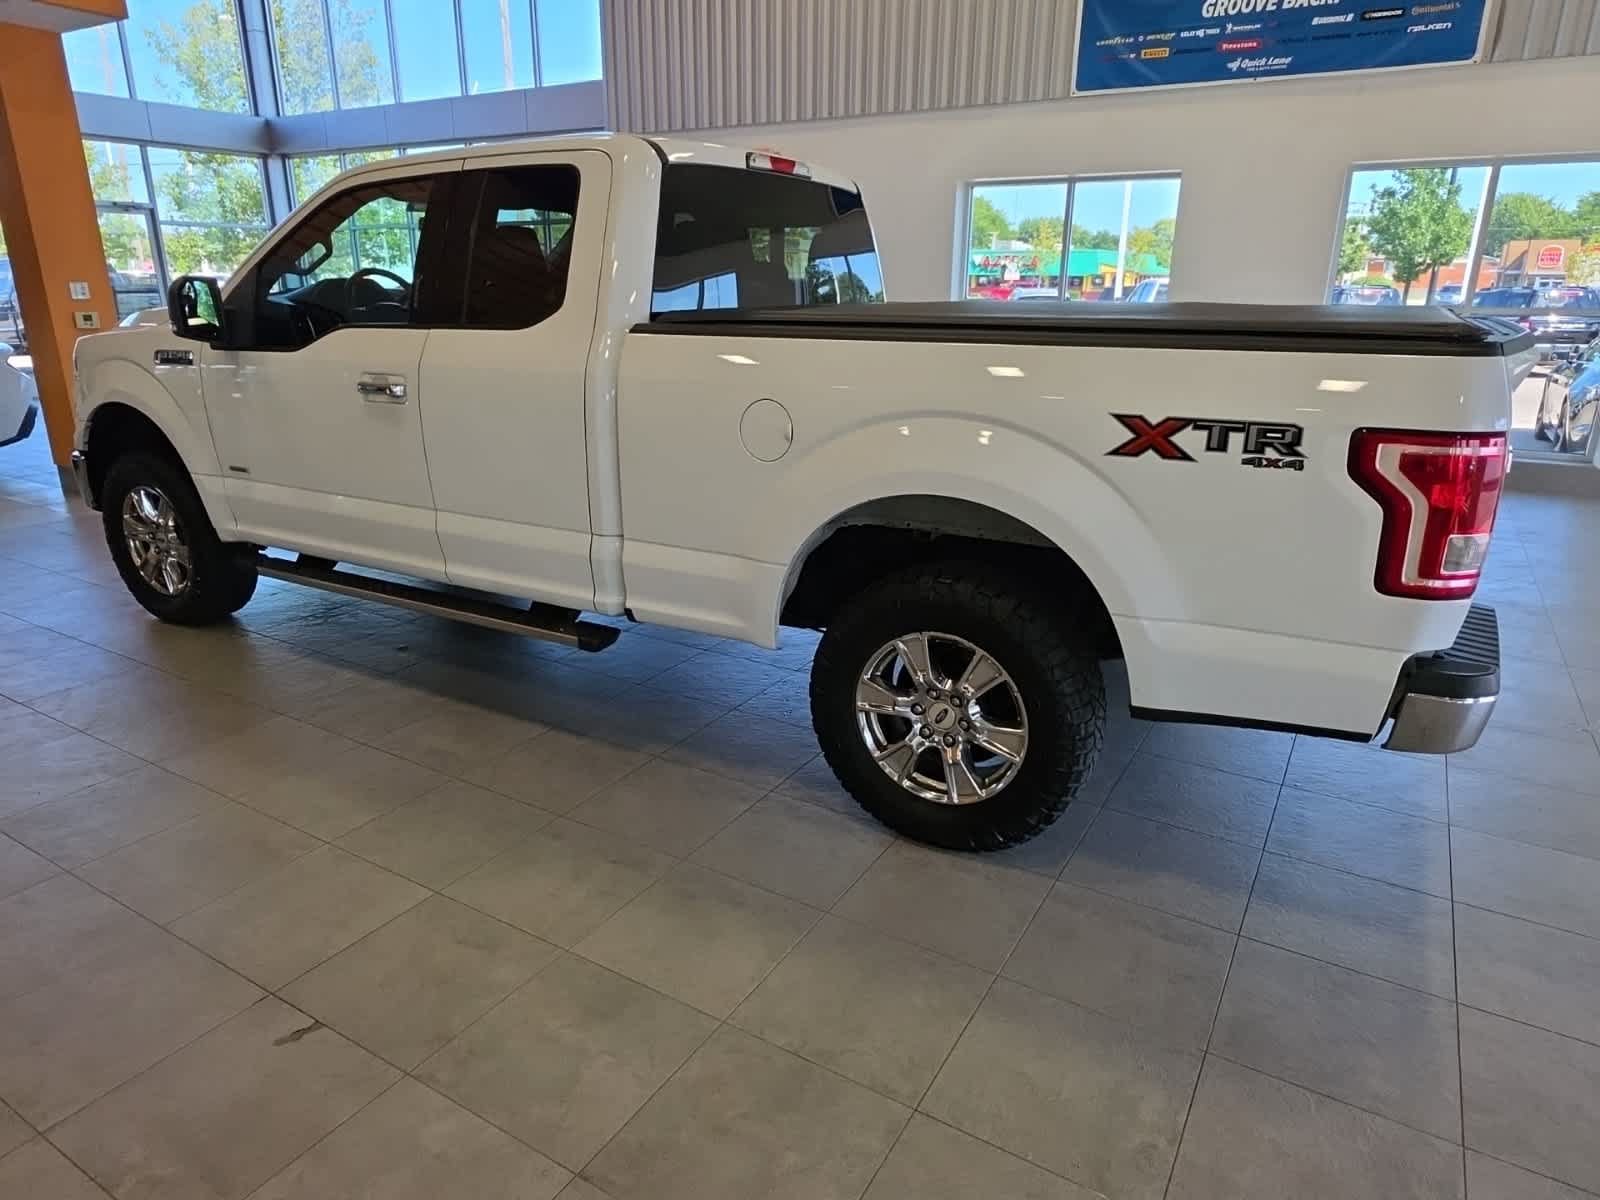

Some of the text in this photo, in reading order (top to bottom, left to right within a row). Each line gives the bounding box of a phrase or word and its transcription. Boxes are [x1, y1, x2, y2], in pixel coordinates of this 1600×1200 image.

[1407, 22, 1453, 32] FALKEN
[1241, 56, 1294, 68] Quick Lane
[1104, 411, 1309, 463] XTR
